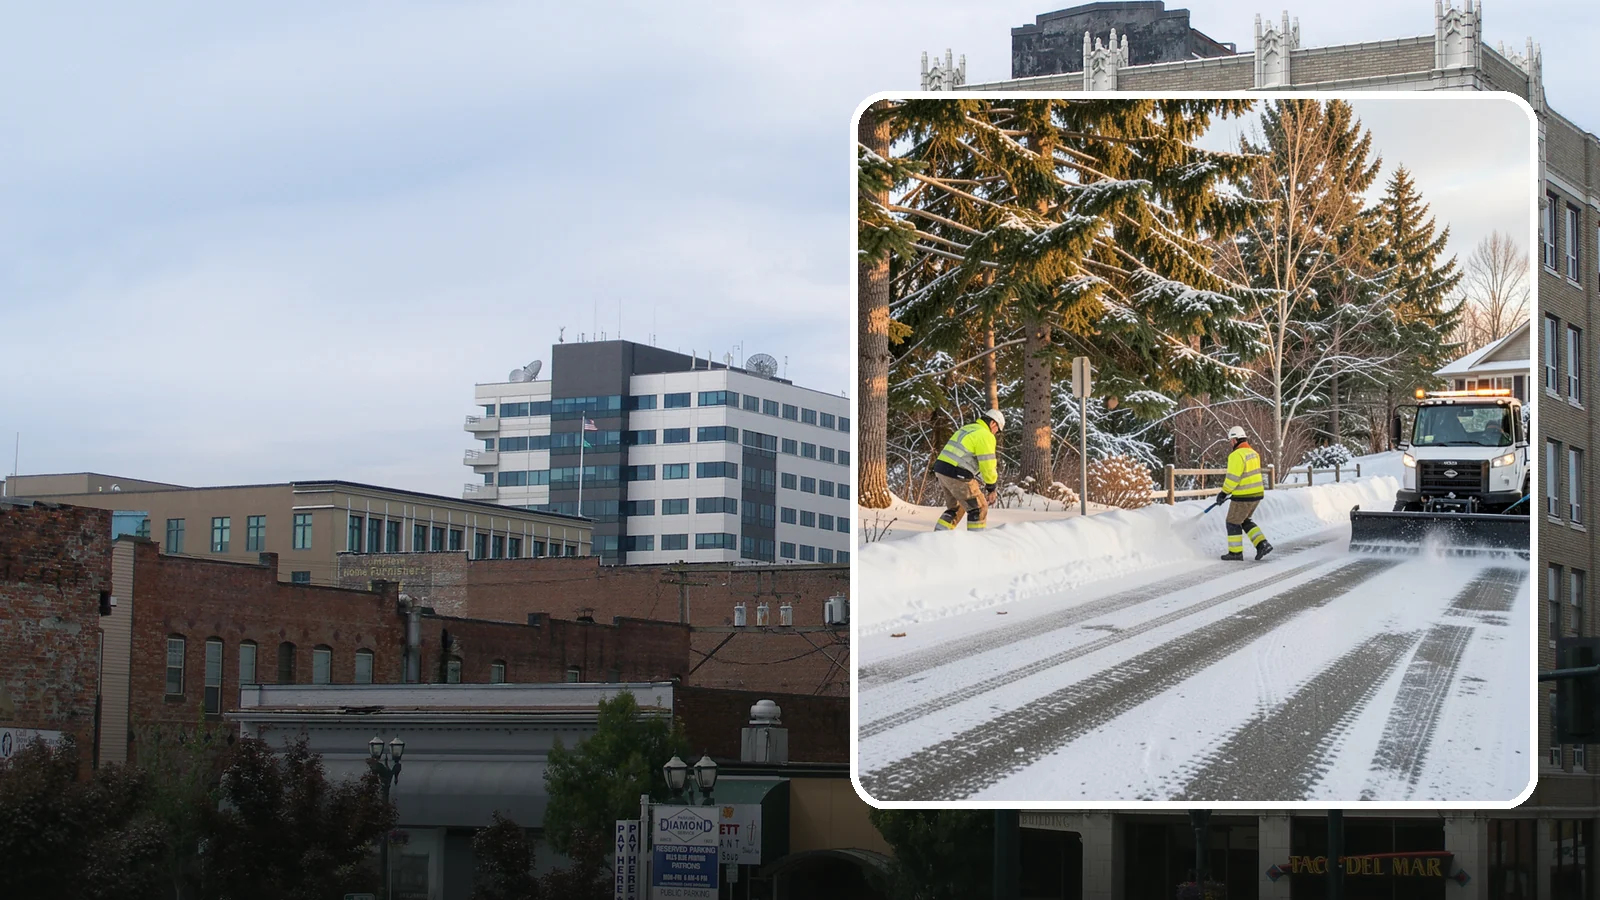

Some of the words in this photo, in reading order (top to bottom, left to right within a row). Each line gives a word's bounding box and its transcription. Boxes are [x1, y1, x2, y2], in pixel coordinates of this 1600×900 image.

[370, 566, 427, 577] Furnishers
[660, 818, 712, 832] DIAMOND
[1022, 816, 1069, 828] BUILDING
[722, 852, 739, 862] Soup
[1346, 856, 1385, 875] DEL
[1392, 857, 1442, 876] MAR
[617, 856, 625, 893] HERE
[628, 856, 636, 893] HERE
[660, 888, 682, 897] PUBLIC
[684, 890, 710, 898] PARKING
